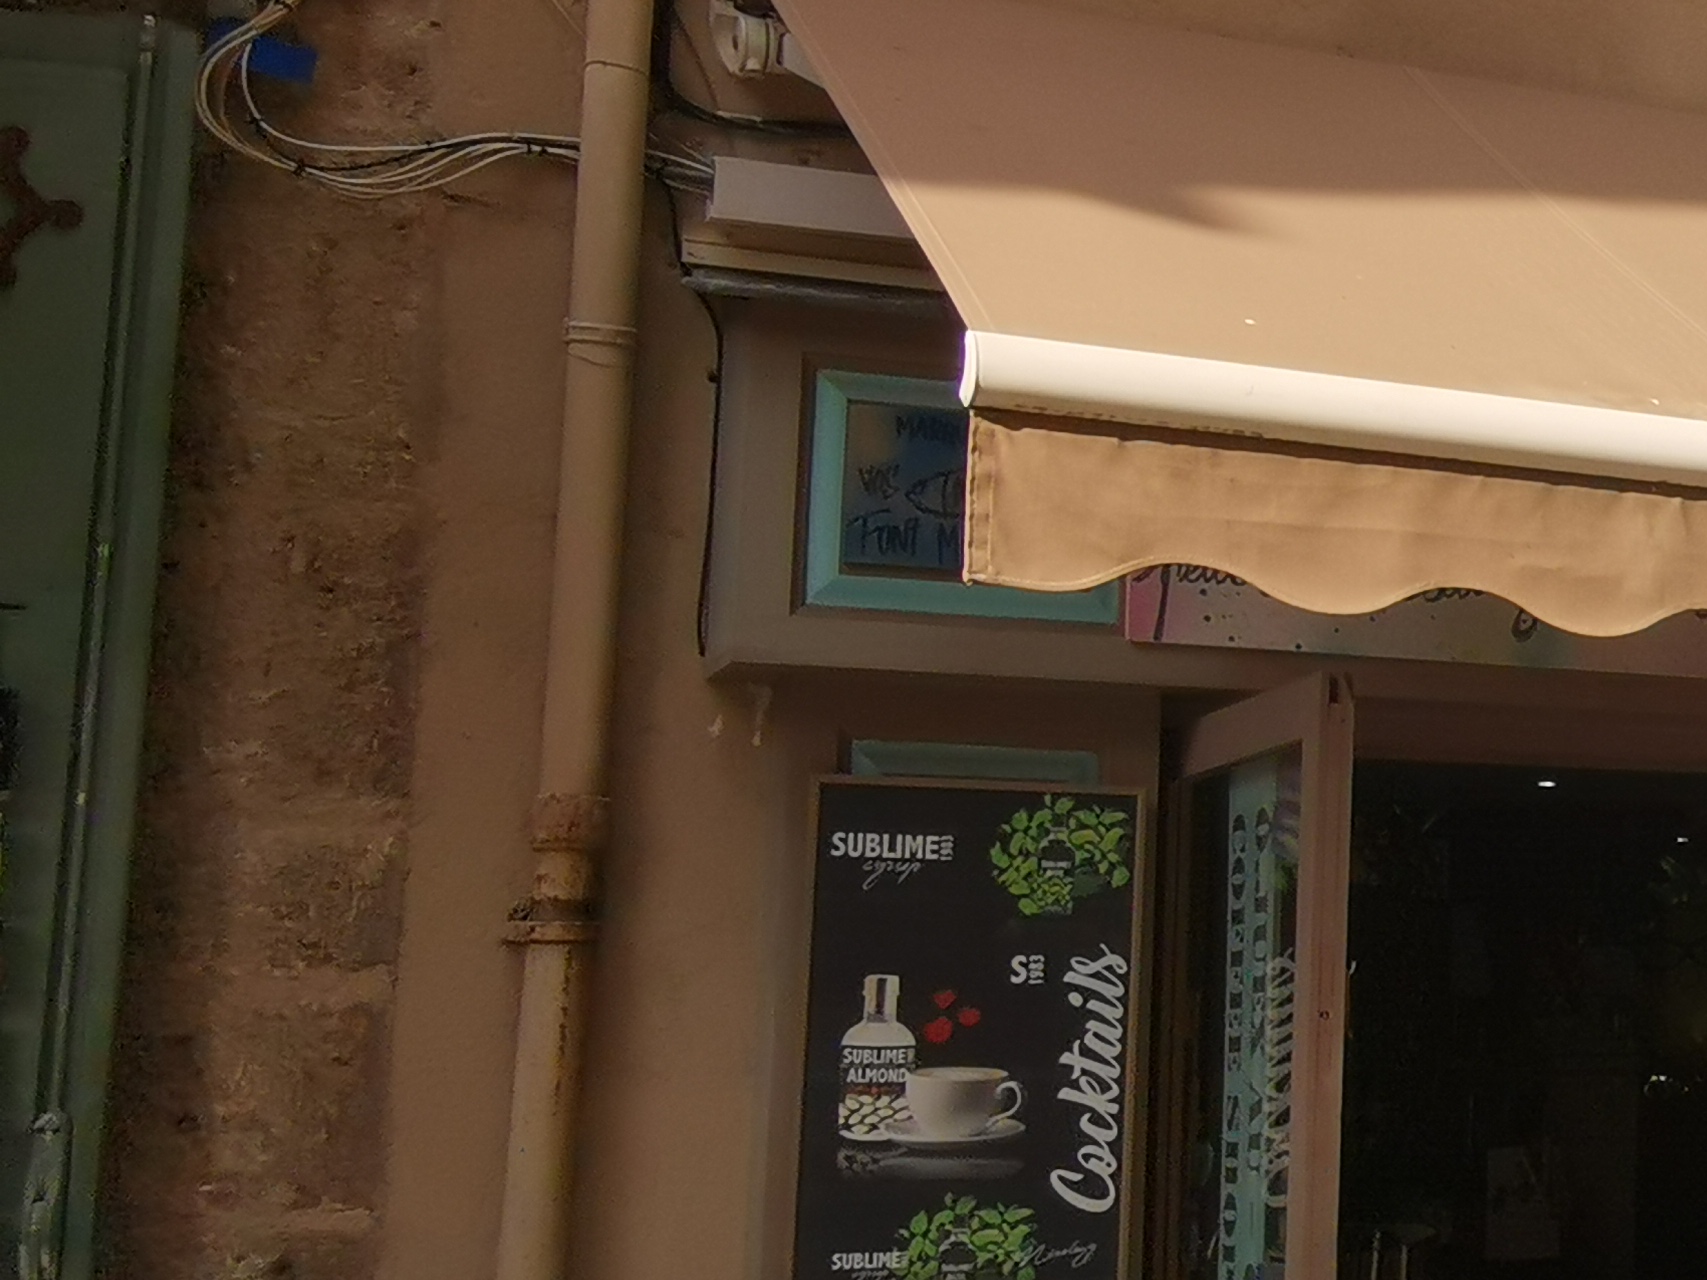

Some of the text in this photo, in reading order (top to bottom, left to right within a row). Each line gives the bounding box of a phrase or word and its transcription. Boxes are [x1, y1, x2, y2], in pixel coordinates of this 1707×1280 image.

[830, 832, 939, 860] SUBLIME
[842, 1047, 908, 1066] SUBLIME
[846, 1066, 909, 1084] ALMOND
[1049, 943, 1128, 1214] Cocktails
[831, 1251, 902, 1272] SUBLIME
